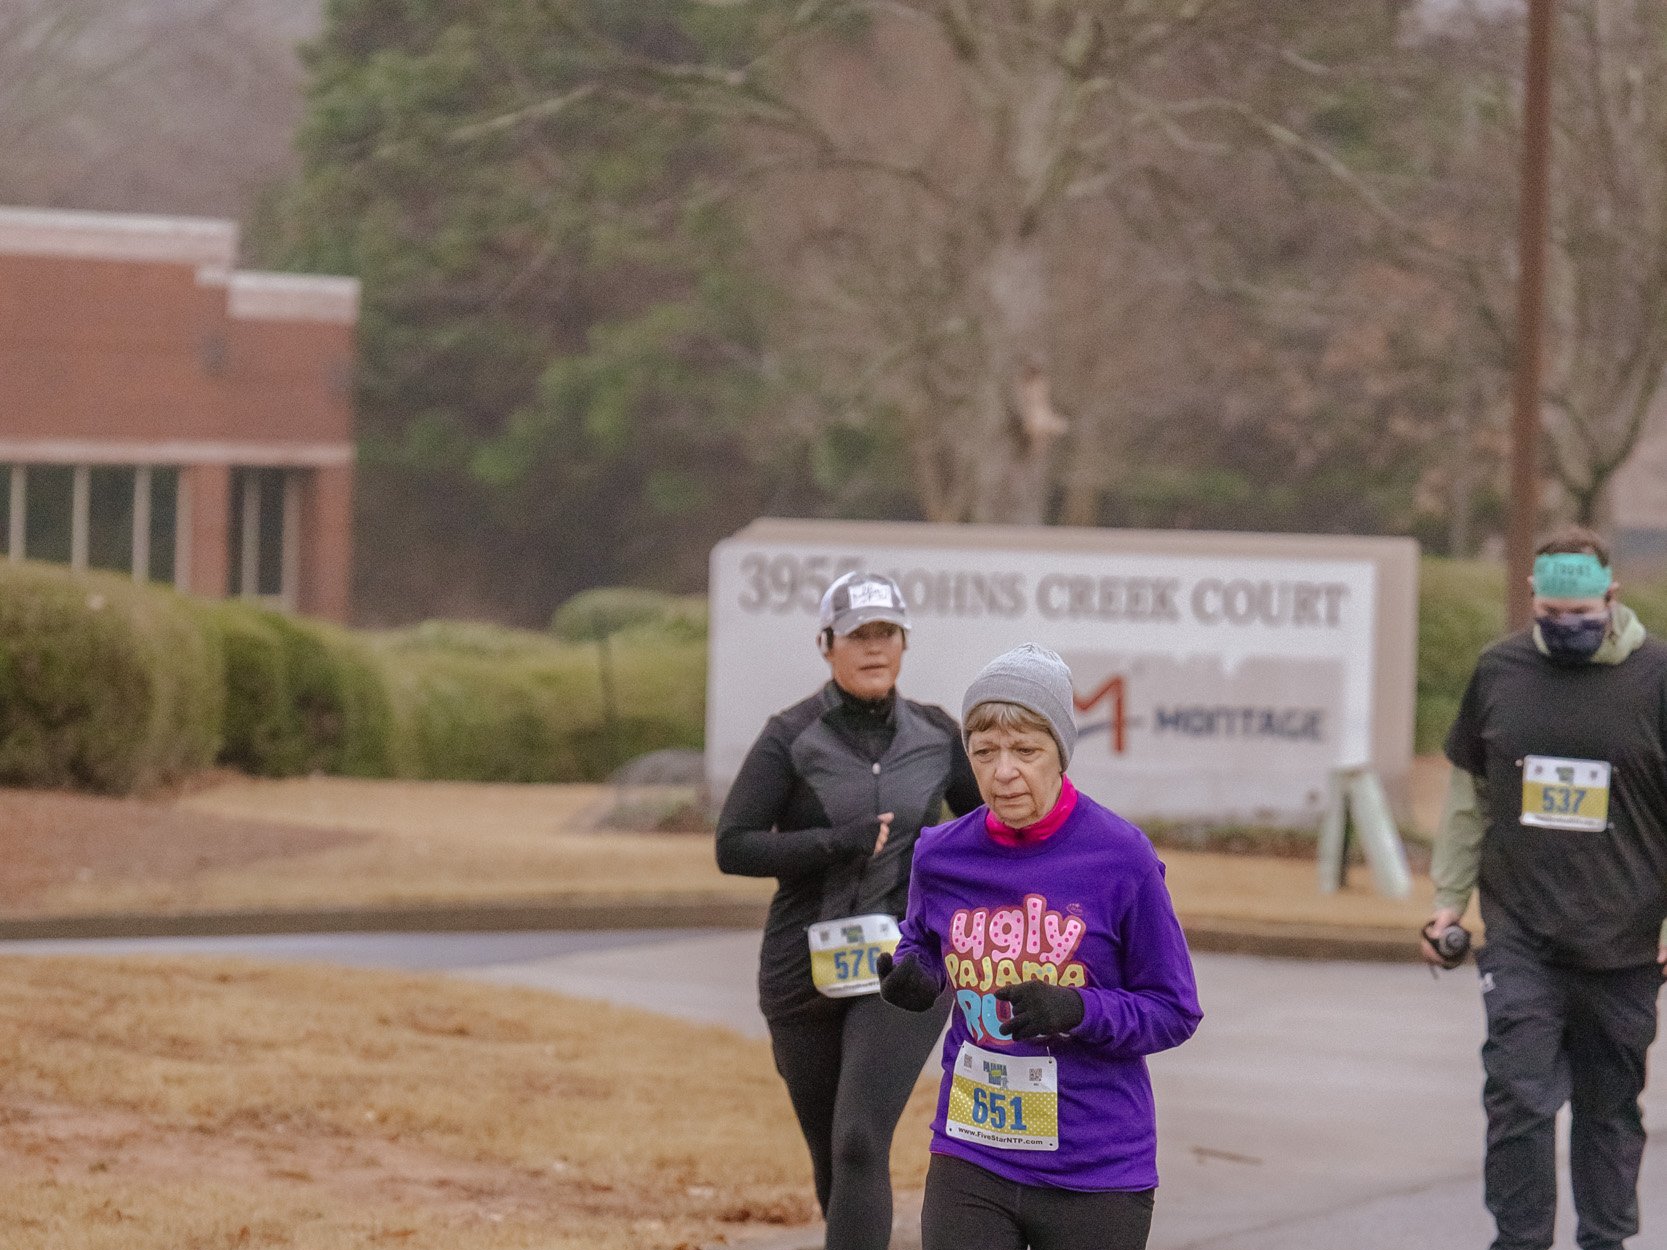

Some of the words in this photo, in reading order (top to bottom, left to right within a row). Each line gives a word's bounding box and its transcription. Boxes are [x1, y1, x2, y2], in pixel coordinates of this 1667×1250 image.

[738, 553, 865, 615] 395
[886, 567, 1027, 618] OHNS
[1035, 573, 1183, 624] CREEK
[1191, 577, 1349, 628] COURT
[1542, 786, 1587, 814] 537
[951, 896, 1083, 966] ugly
[971, 1086, 1028, 1131] 651
[957, 1126, 1043, 1145] www.FiveStarNTP.com
